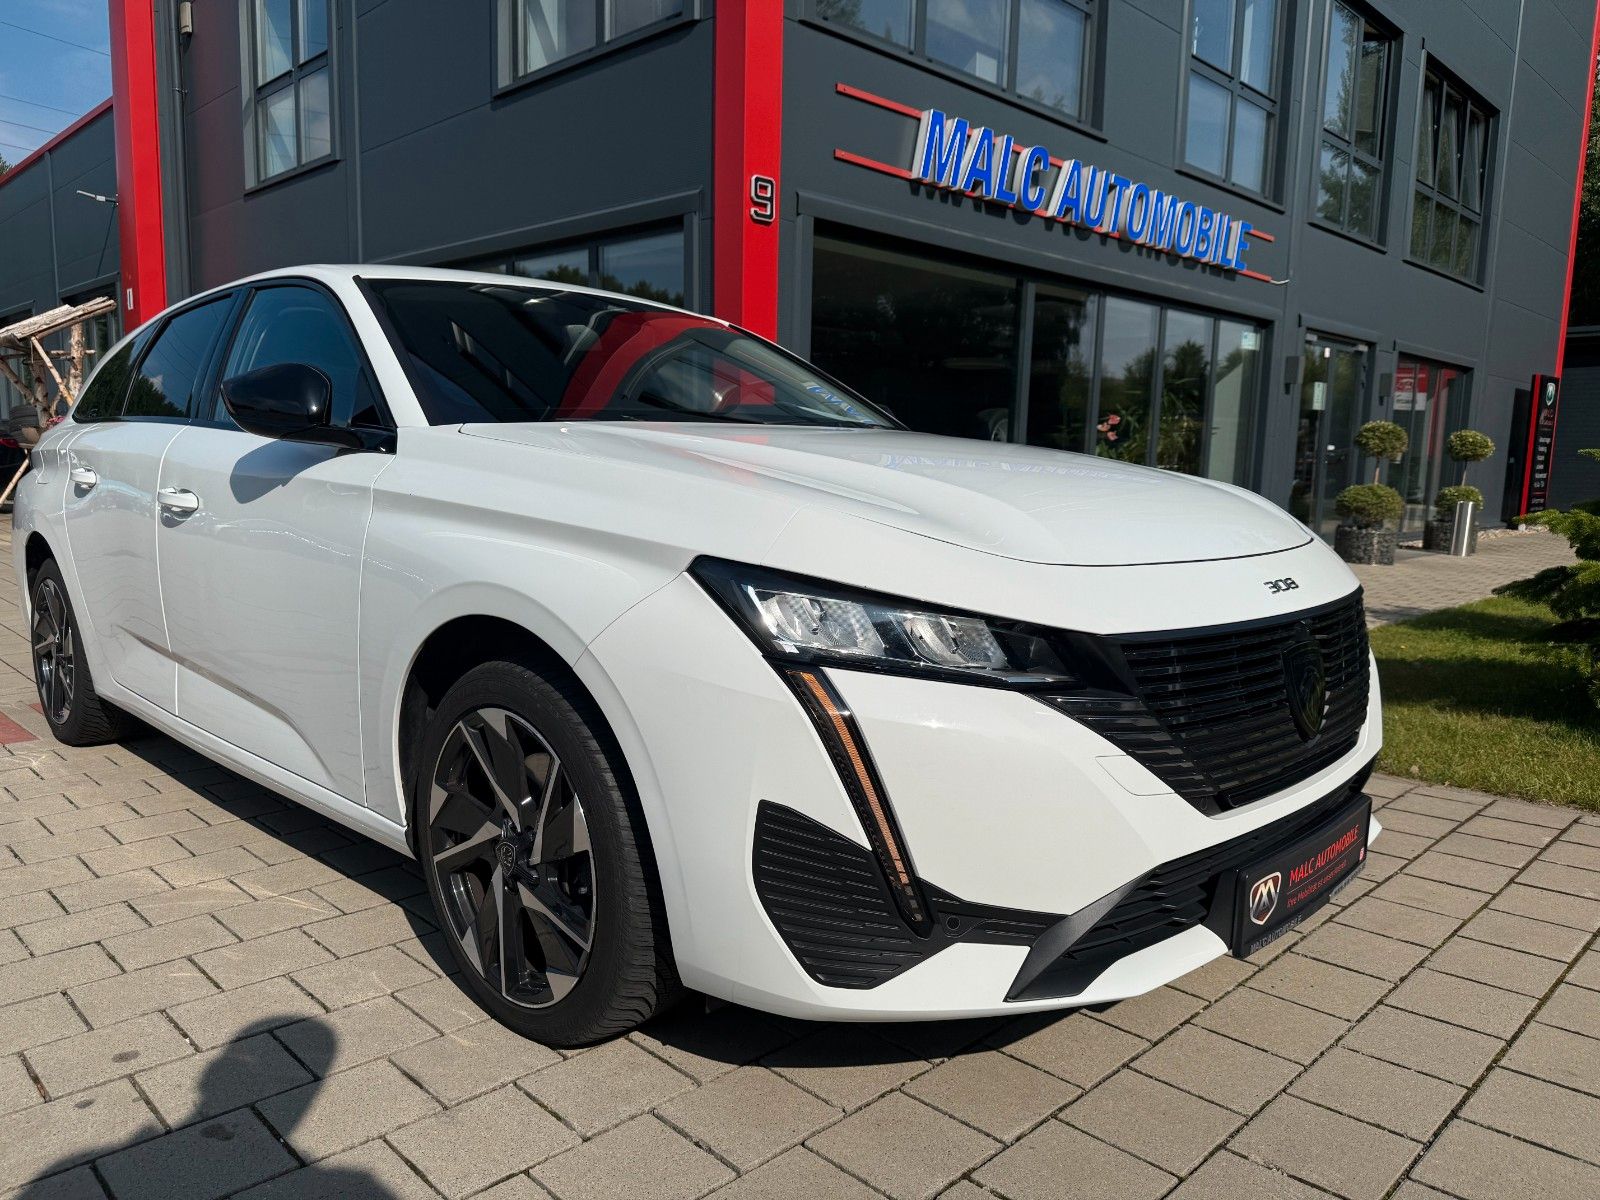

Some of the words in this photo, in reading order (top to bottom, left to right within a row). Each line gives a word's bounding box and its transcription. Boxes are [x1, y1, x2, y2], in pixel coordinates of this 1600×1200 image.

[750, 174, 776, 222] 9
[914, 108, 1050, 211] MALC
[1052, 159, 1253, 271] AUTOMOBILE
[1263, 577, 1299, 594] 308
[1289, 858, 1314, 887] MALC
[1315, 825, 1360, 869] AUTOMOBILE
